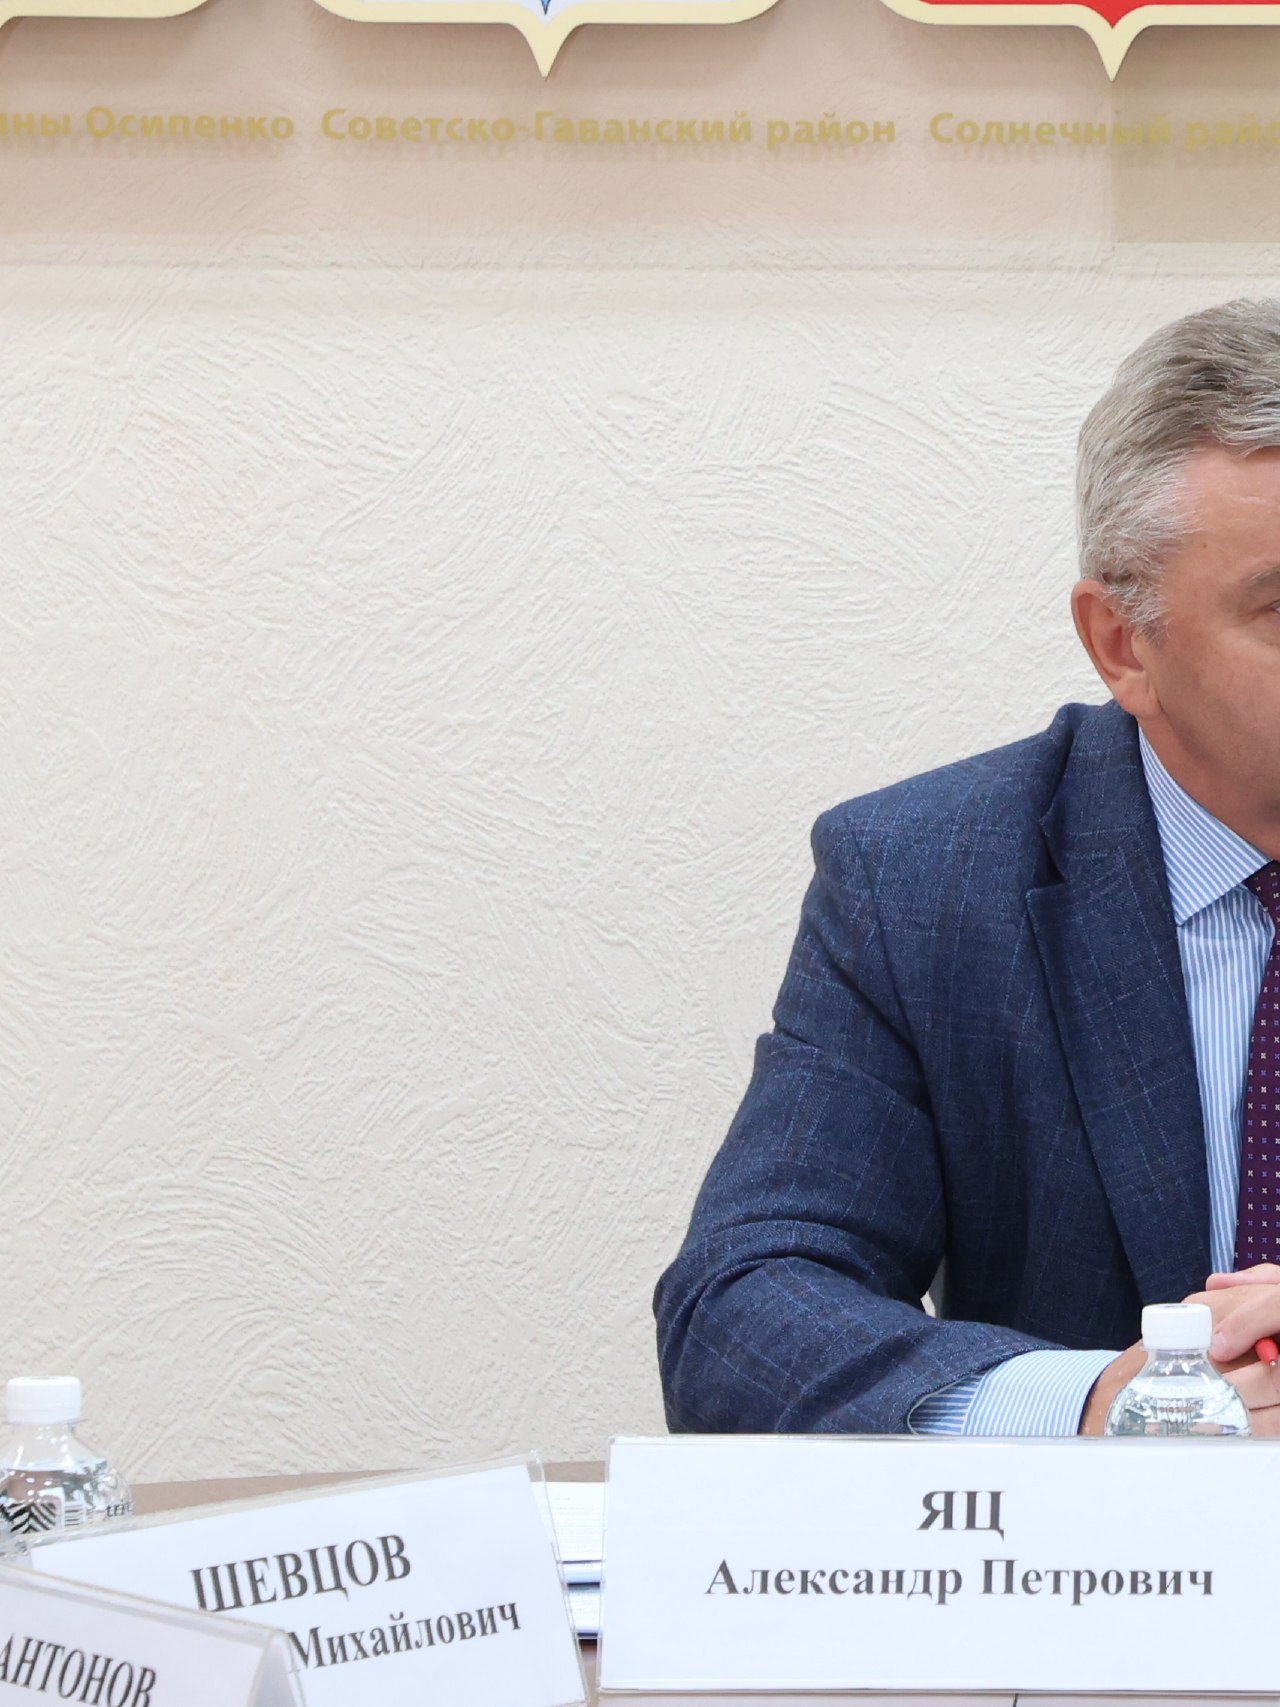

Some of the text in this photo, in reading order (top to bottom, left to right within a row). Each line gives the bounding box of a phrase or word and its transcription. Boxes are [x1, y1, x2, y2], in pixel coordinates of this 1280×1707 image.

[86, 105, 294, 140] Осипенко
[321, 107, 897, 151] Советско-Гаванский район
[929, 111, 1171, 146] Солнечный
[917, 1490, 1006, 1541] ЯЦ
[189, 1534, 412, 1612] ШЕВЦОВ
[705, 1558, 1214, 1606] Александр Петрович
[287, 1602, 521, 1672] Михайлович
[0, 1633, 156, 1707] АНТОНОВ
